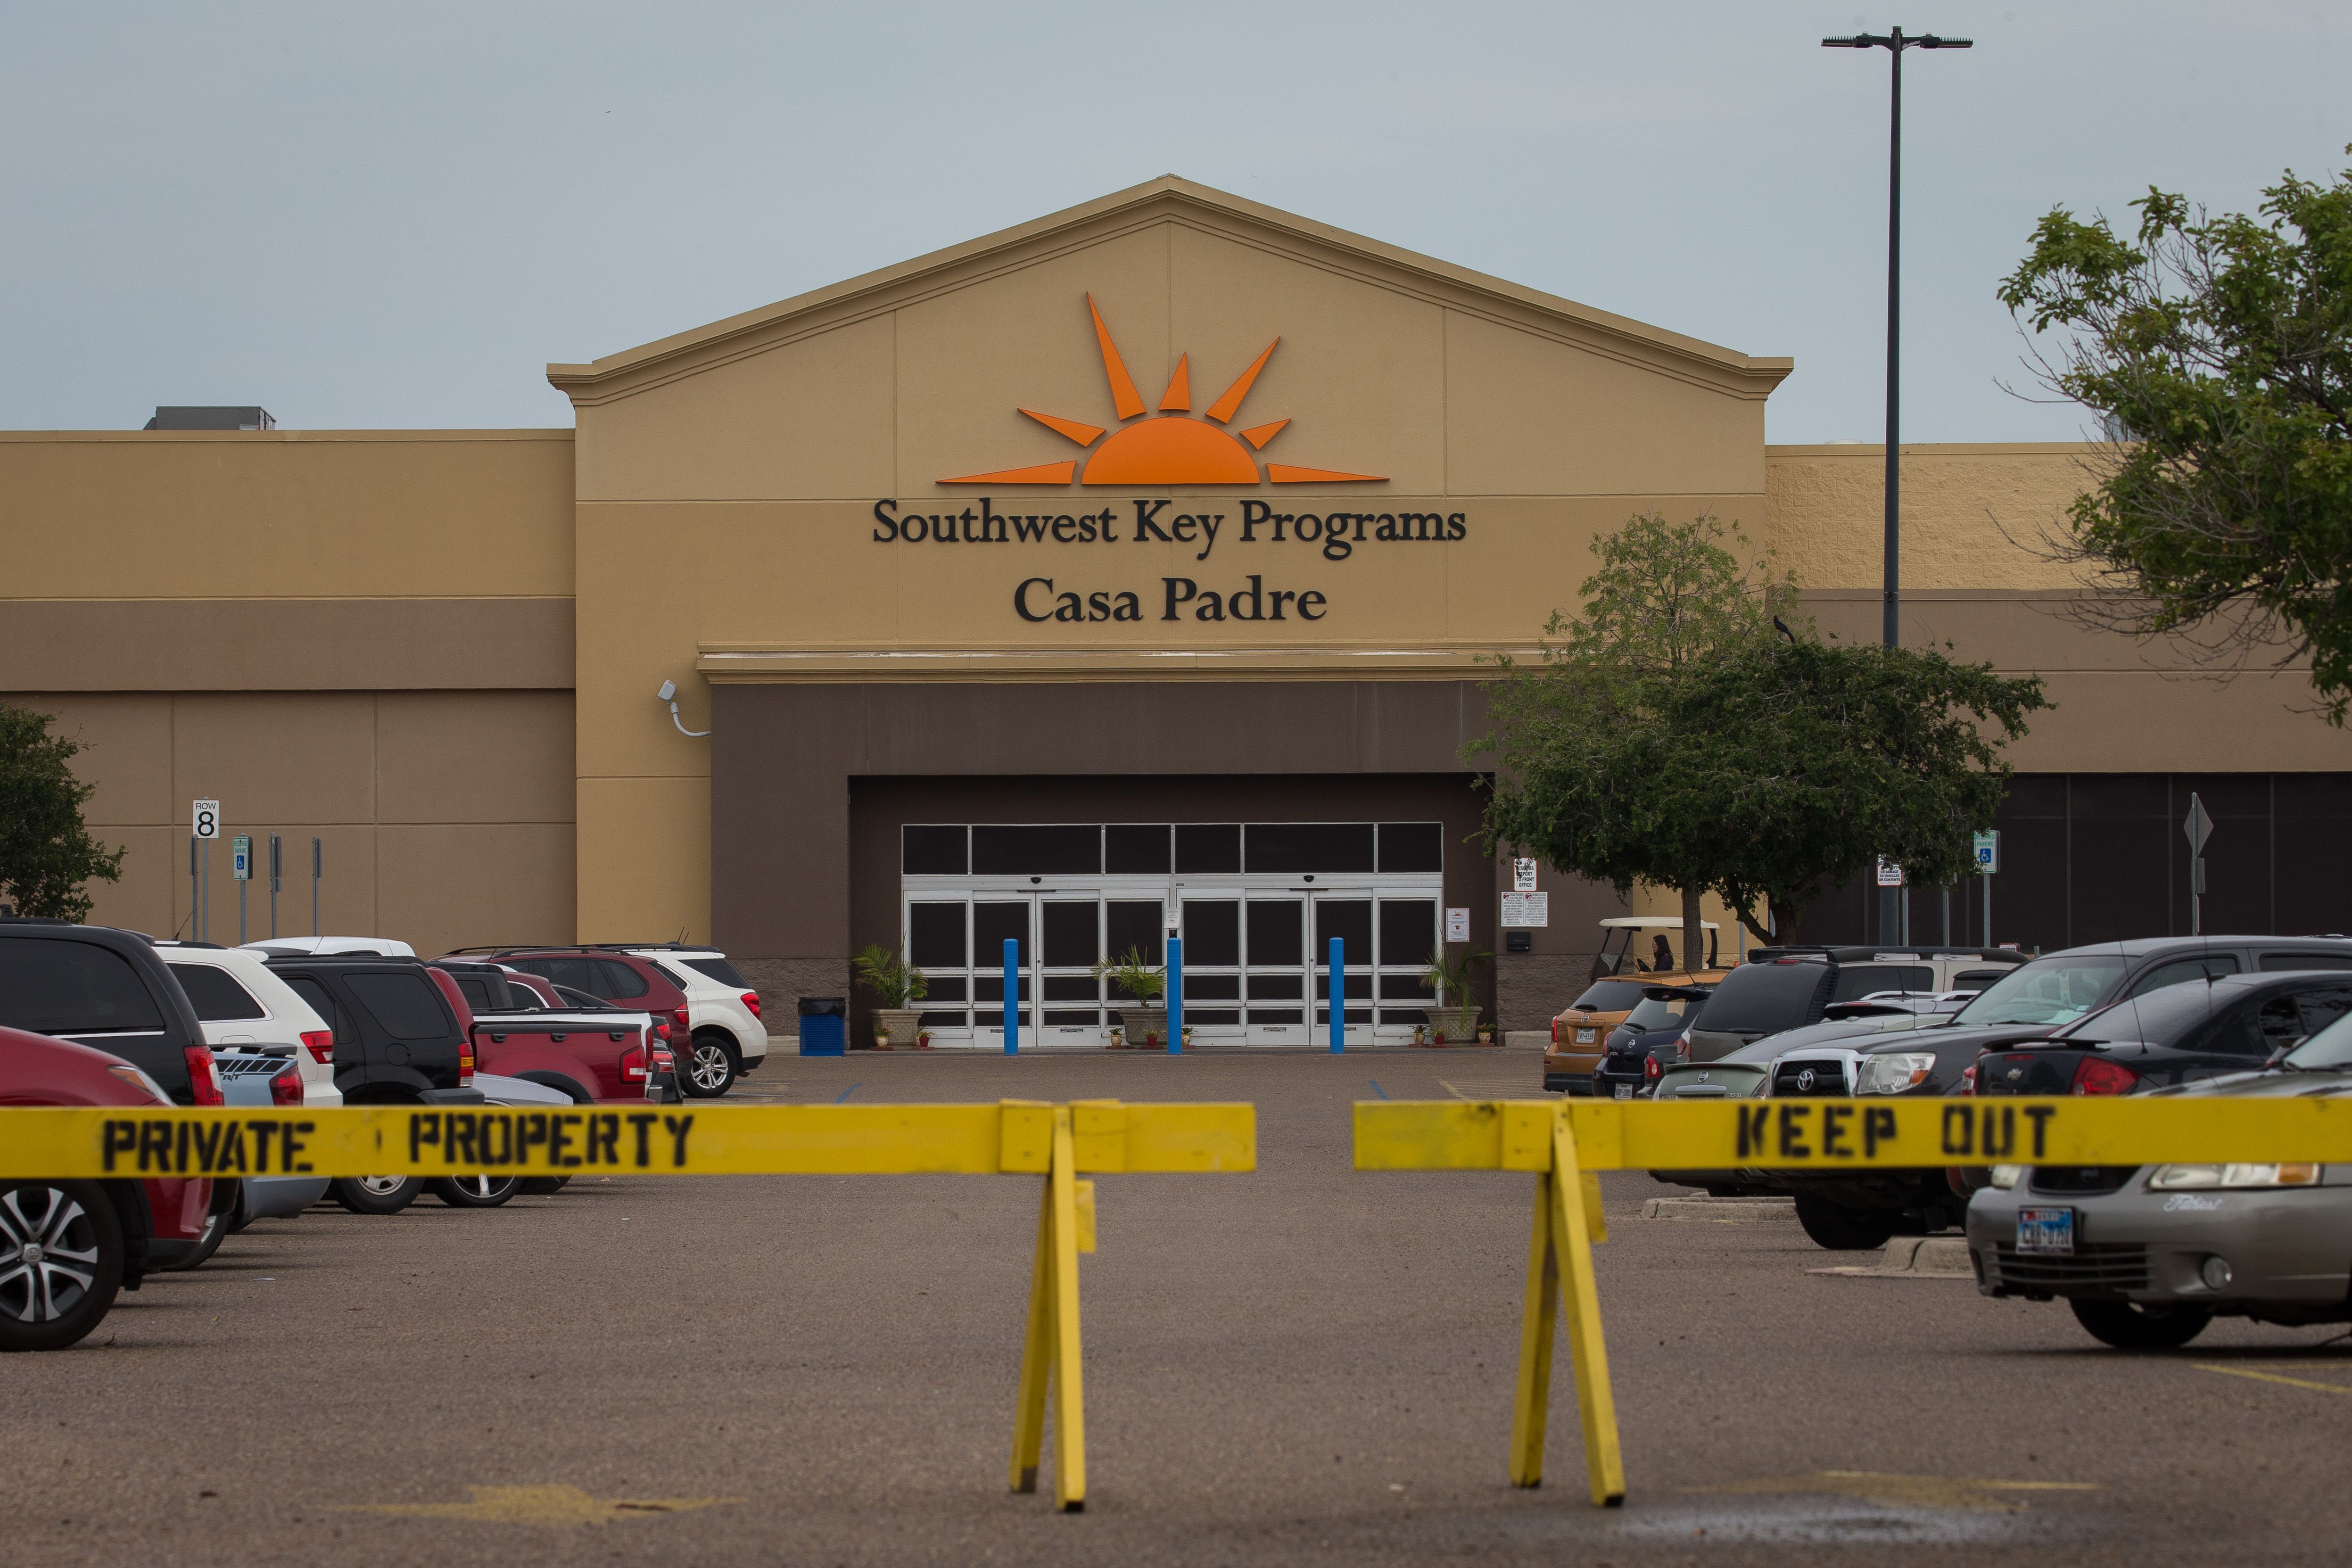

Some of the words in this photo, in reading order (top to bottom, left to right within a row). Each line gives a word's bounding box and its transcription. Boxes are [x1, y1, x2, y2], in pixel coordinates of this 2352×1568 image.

[874, 498, 1118, 543] Southwest
[1133, 500, 1225, 561] Key
[1239, 500, 1466, 561] Programs
[1014, 578, 1144, 622] Casa
[1160, 574, 1327, 621] Padre
[197, 811, 215, 837] 8
[223, 1072, 242, 1082] R/T
[102, 1120, 314, 1172] PRIVATE
[409, 1113, 693, 1167] PROPERTY
[1736, 1105, 1897, 1158] KEEP
[1942, 1105, 2056, 1158] OUT
